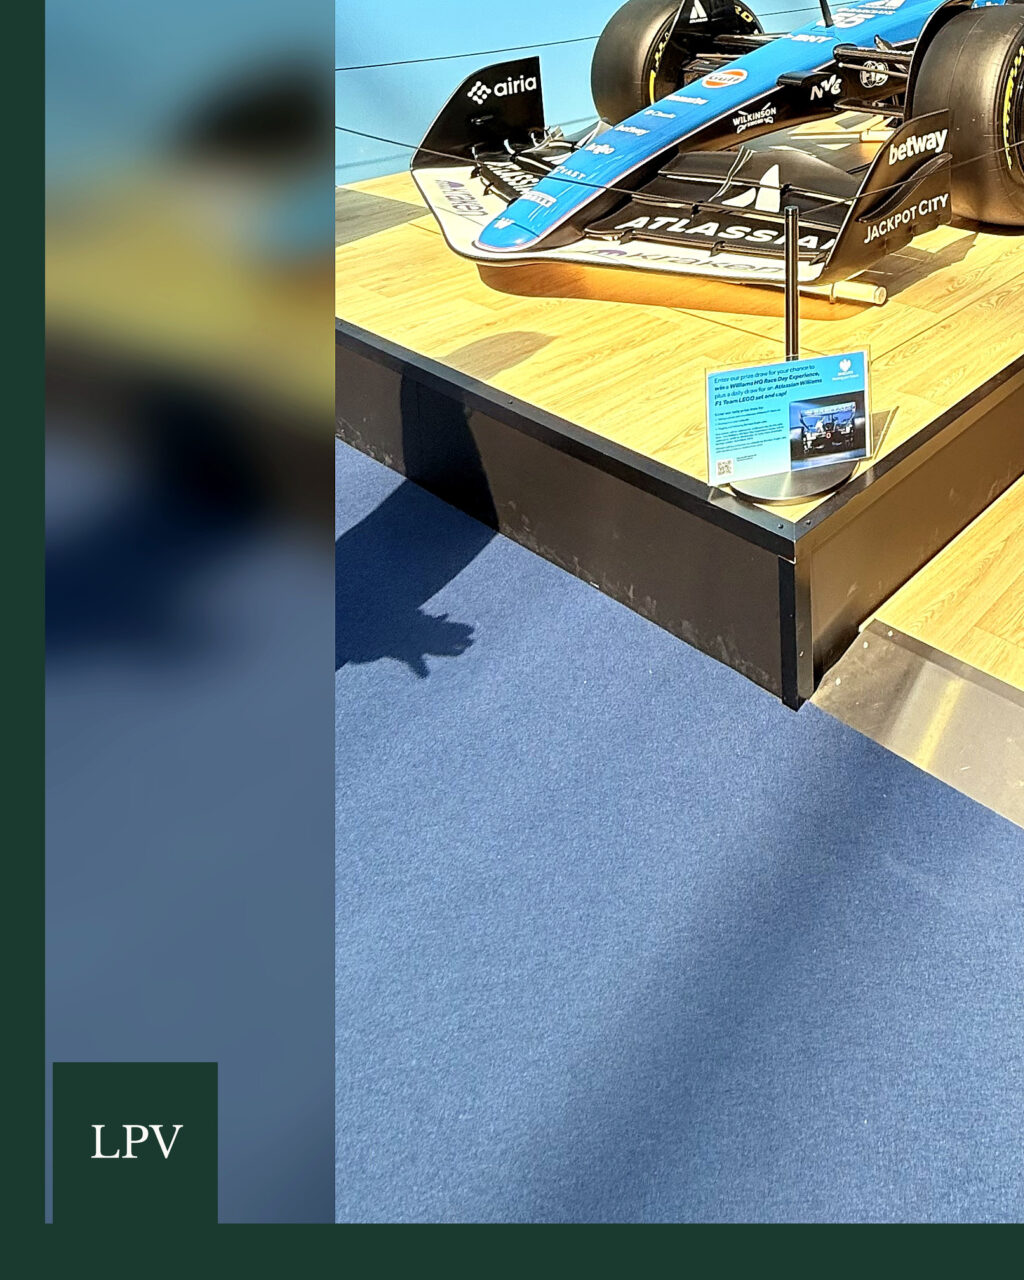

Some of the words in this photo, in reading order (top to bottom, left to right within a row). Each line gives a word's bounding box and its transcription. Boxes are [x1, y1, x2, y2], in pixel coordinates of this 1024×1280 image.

[493, 74, 537, 97] airia
[732, 106, 777, 127] WILKINSON
[887, 127, 949, 166] betway
[863, 204, 919, 245] JACKPOT
[918, 193, 949, 217] CITY
